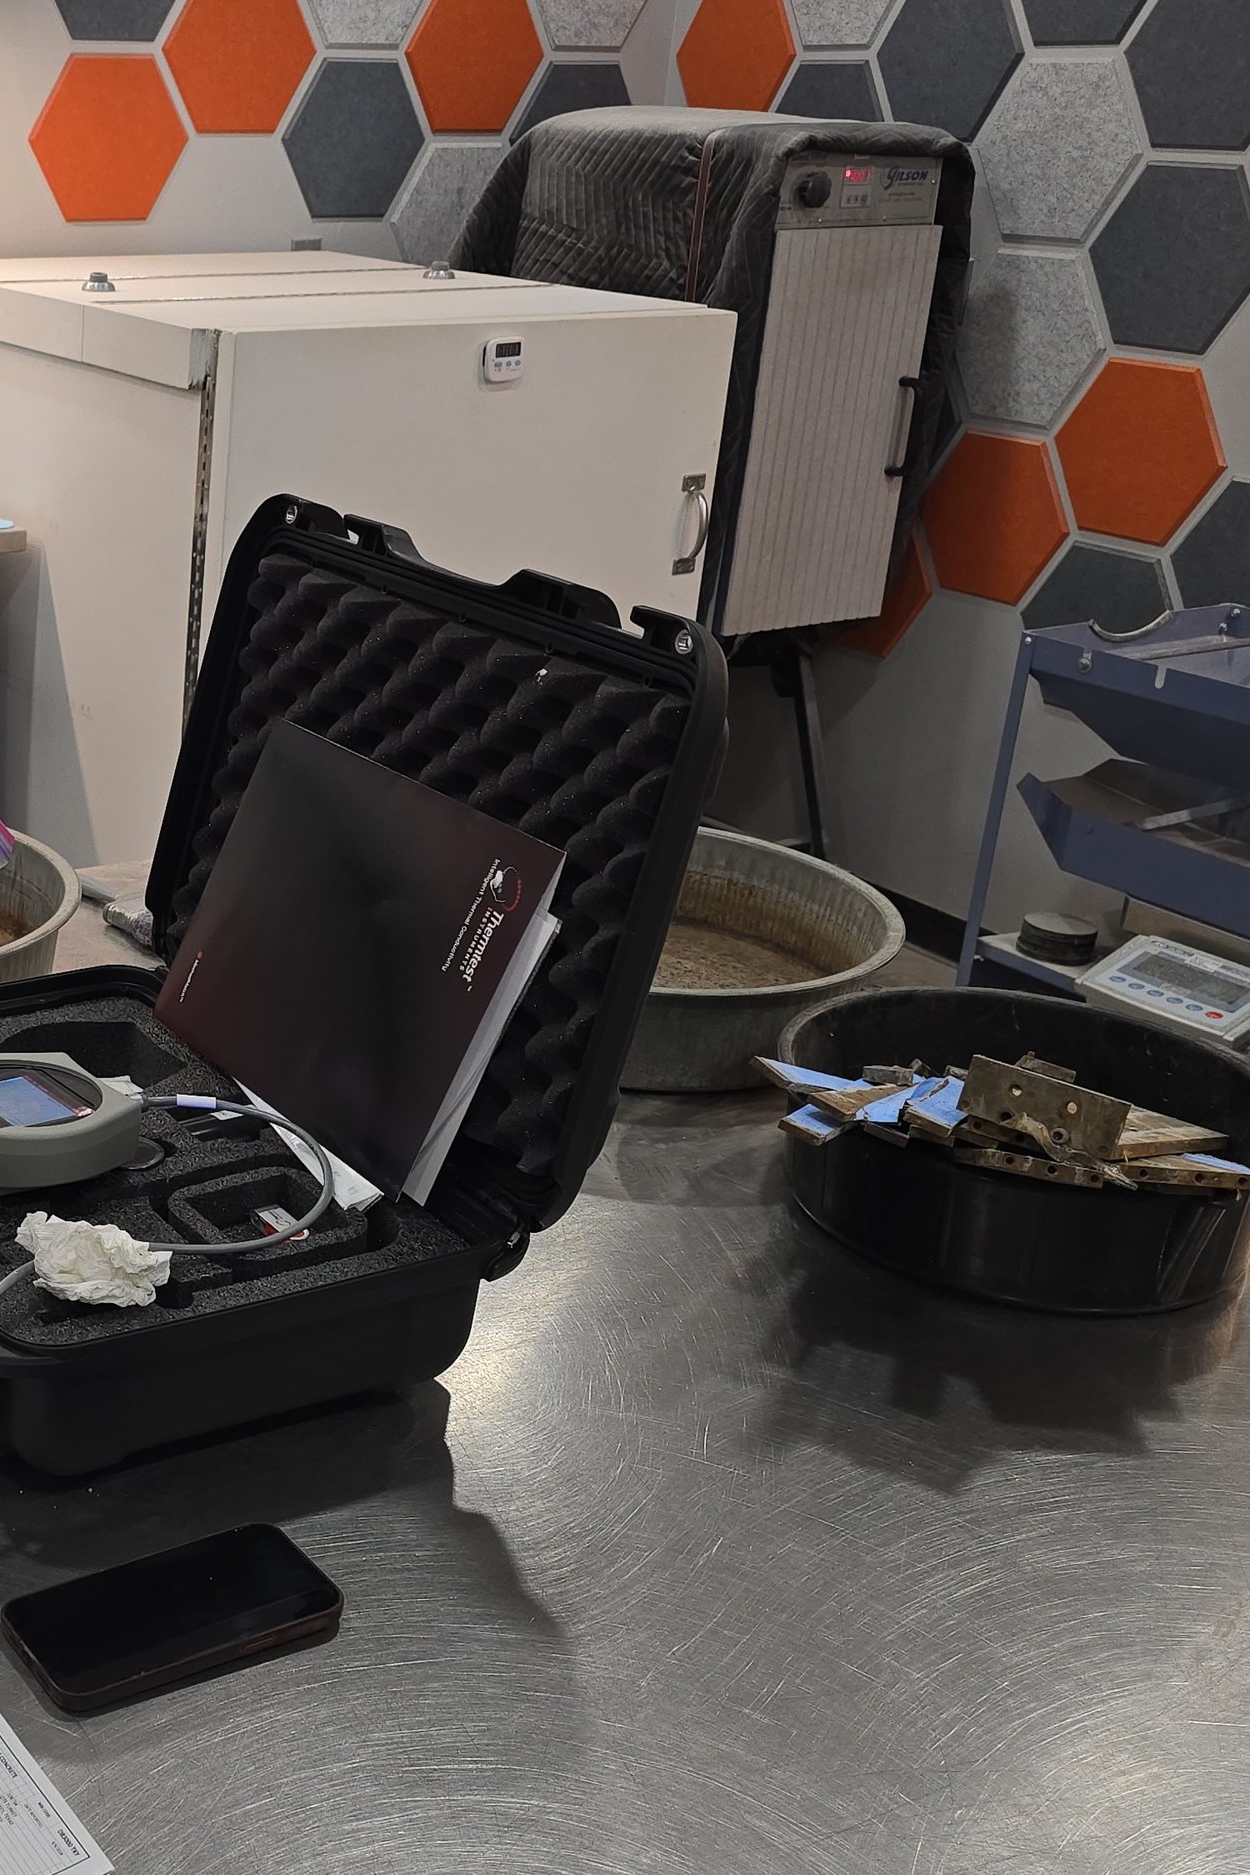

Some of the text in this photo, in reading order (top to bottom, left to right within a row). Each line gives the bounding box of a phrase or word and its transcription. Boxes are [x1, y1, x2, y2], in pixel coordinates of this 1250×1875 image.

[441, 858, 500, 972] Intelligent Thermal Conductivity
[459, 907, 491, 971] INSTRUMENTS
[462, 909, 504, 983] Thermtest
